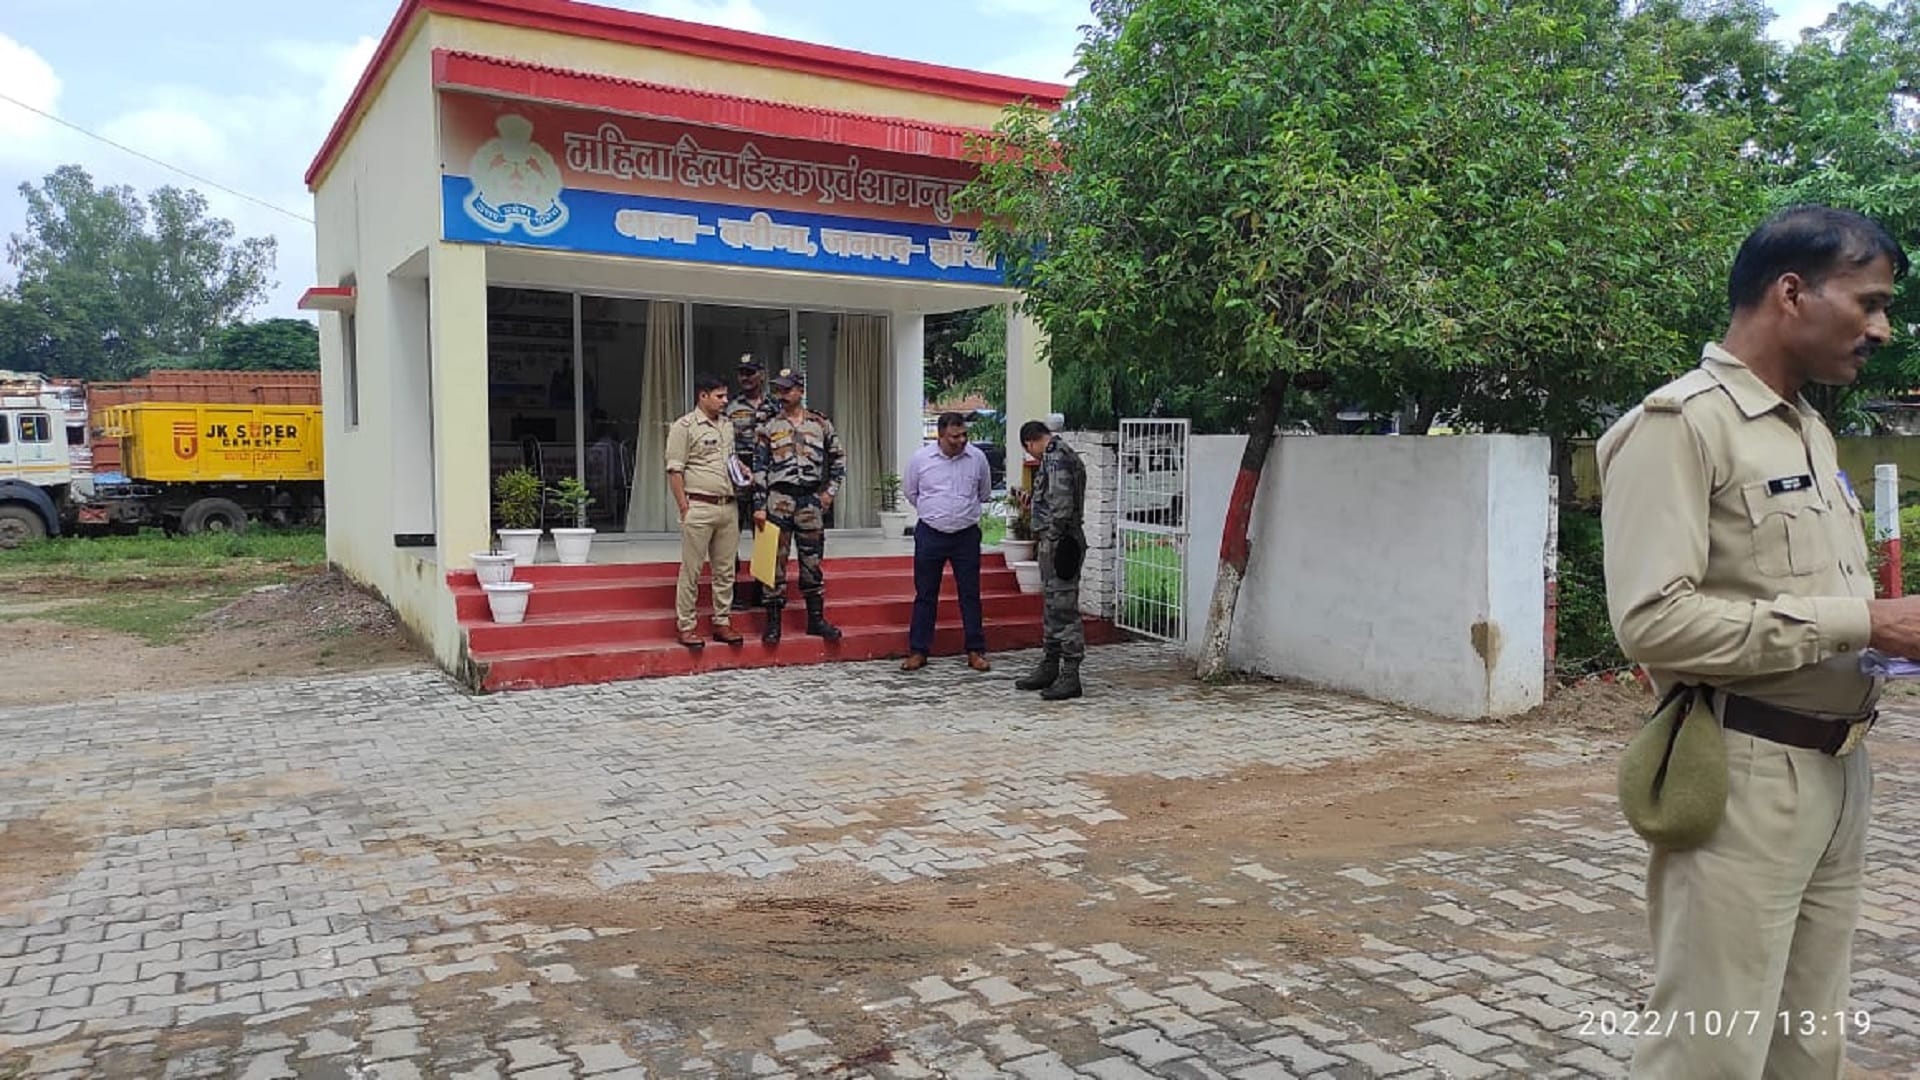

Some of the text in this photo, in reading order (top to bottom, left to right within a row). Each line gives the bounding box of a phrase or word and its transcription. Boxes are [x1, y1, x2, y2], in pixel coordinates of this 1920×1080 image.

[564, 122, 674, 181] महिला
[673, 133, 740, 189] हेल्प
[740, 142, 813, 196] डेस्क
[815, 155, 859, 204] एवं
[206, 424, 228, 438] JK
[222, 438, 281, 447] CEMENT
